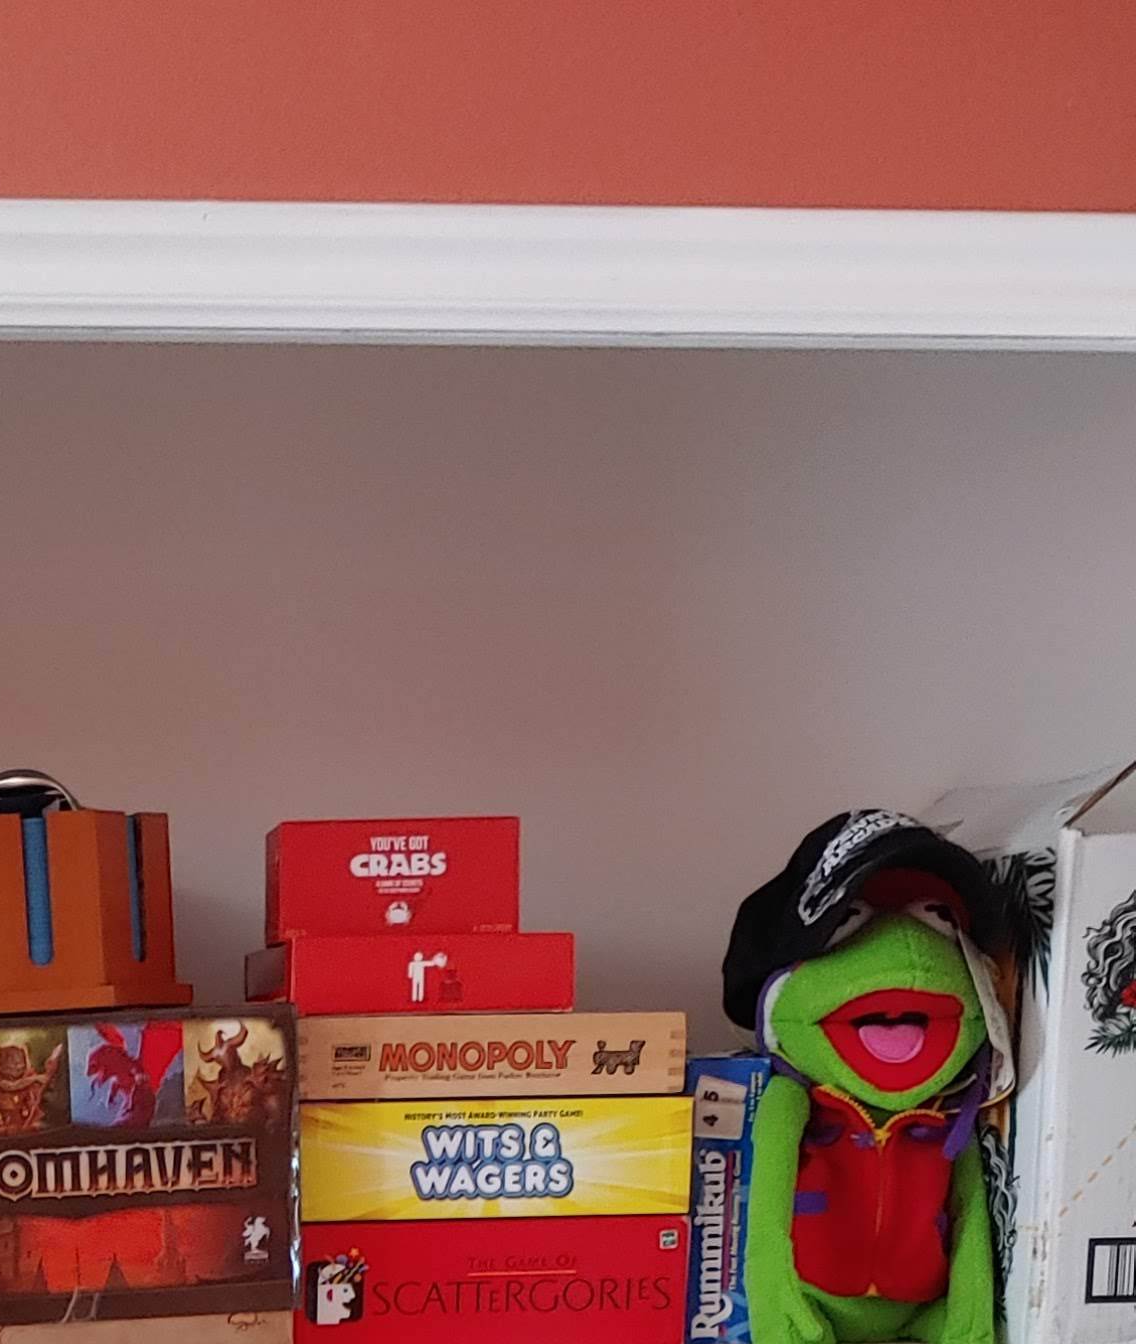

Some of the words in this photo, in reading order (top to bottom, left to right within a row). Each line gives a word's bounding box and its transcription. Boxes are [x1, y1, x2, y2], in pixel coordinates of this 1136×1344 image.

[349, 852, 447, 878] CRABS
[379, 1039, 576, 1072] MONOPOLY
[424, 1128, 524, 1163] WITS
[531, 1125, 560, 1161] &
[413, 1163, 572, 1198] WAGERS
[691, 1149, 732, 1341] Rummikub
[371, 1276, 672, 1316] SCATTERGORIES
